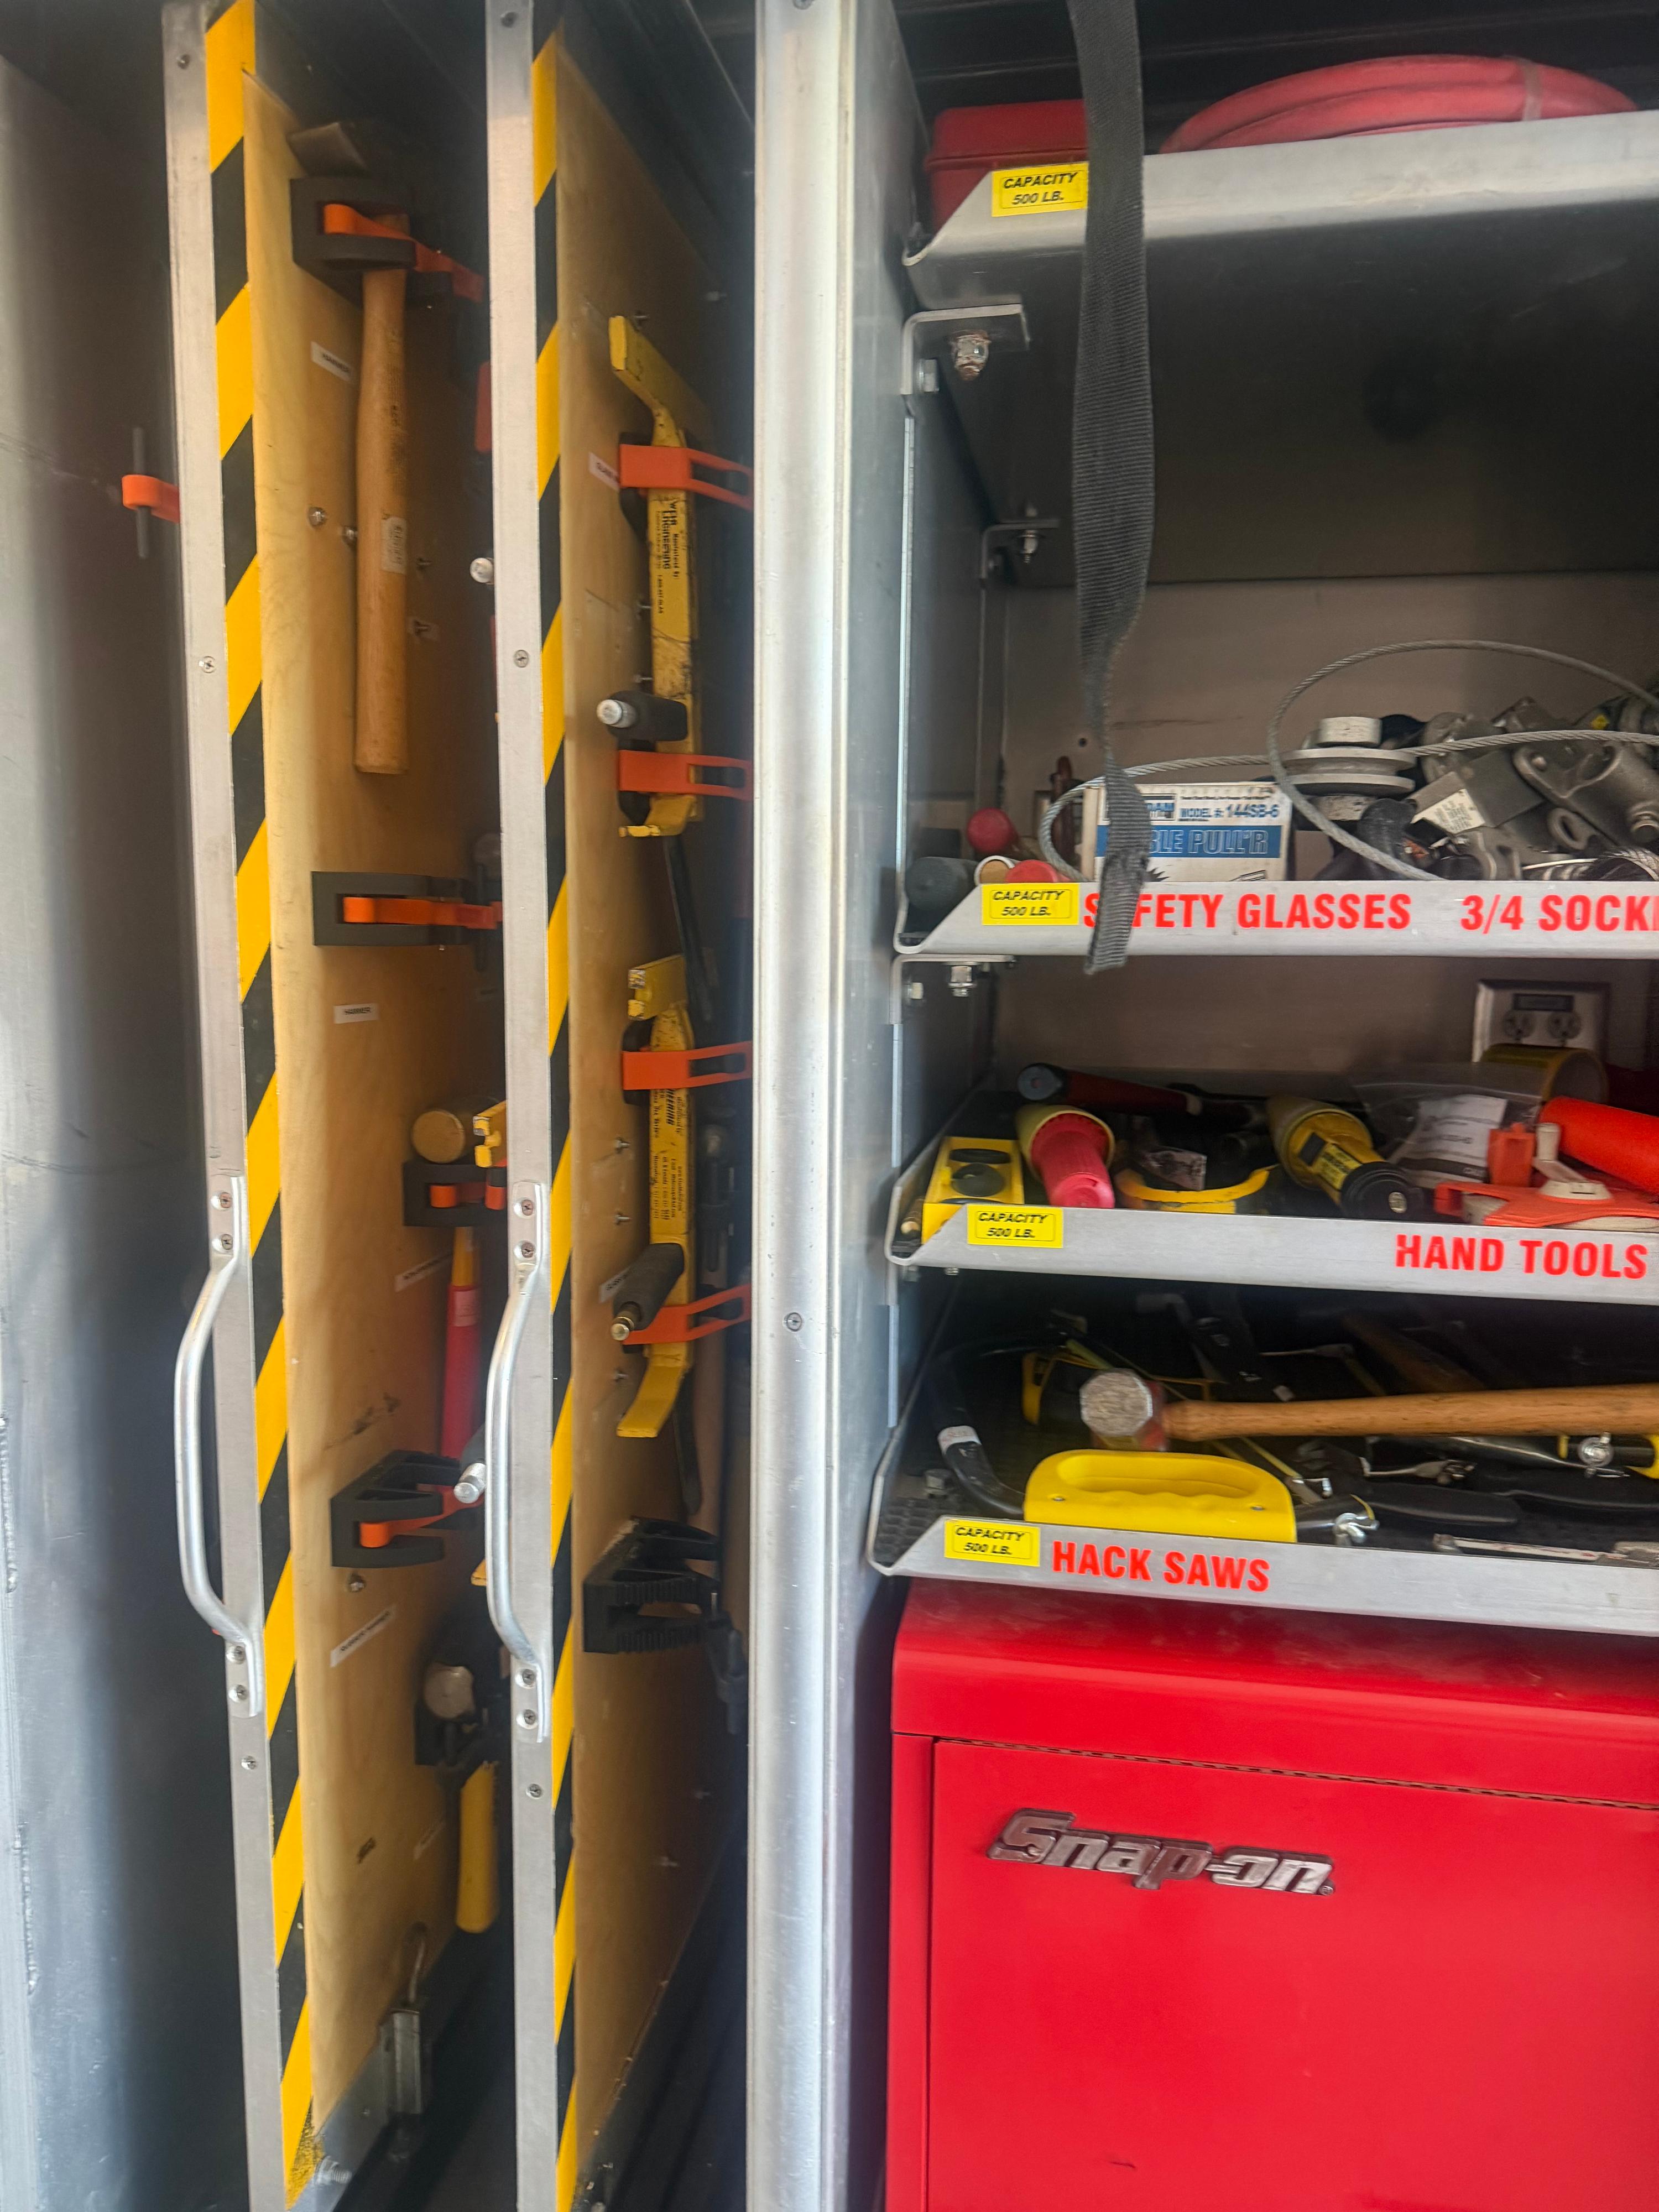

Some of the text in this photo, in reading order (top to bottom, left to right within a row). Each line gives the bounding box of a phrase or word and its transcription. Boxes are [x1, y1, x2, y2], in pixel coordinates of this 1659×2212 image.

[1003, 172, 1078, 189] CAPACITY
[1011, 191, 1064, 205] 500 LB.
[1226, 804, 1280, 818] 144SB-6
[1150, 830, 1183, 853] BLE
[993, 891, 1065, 900] CAPACITY
[1001, 906, 1051, 916] 500 LB.
[1083, 893, 1411, 930] SFETY GLASSES
[1460, 894, 1524, 933] 3/4
[978, 1212, 1048, 1224] CAPACITY
[986, 1228, 1036, 1238] 500 LB.
[1395, 1234, 1648, 1280] HAND TOOLS
[956, 1527, 1025, 1541] CAPACITY
[963, 1542, 1013, 1555] 500 LB.
[1052, 1540, 1271, 1593] HACK SAWS
[987, 1807, 1334, 1895] Snap-on
